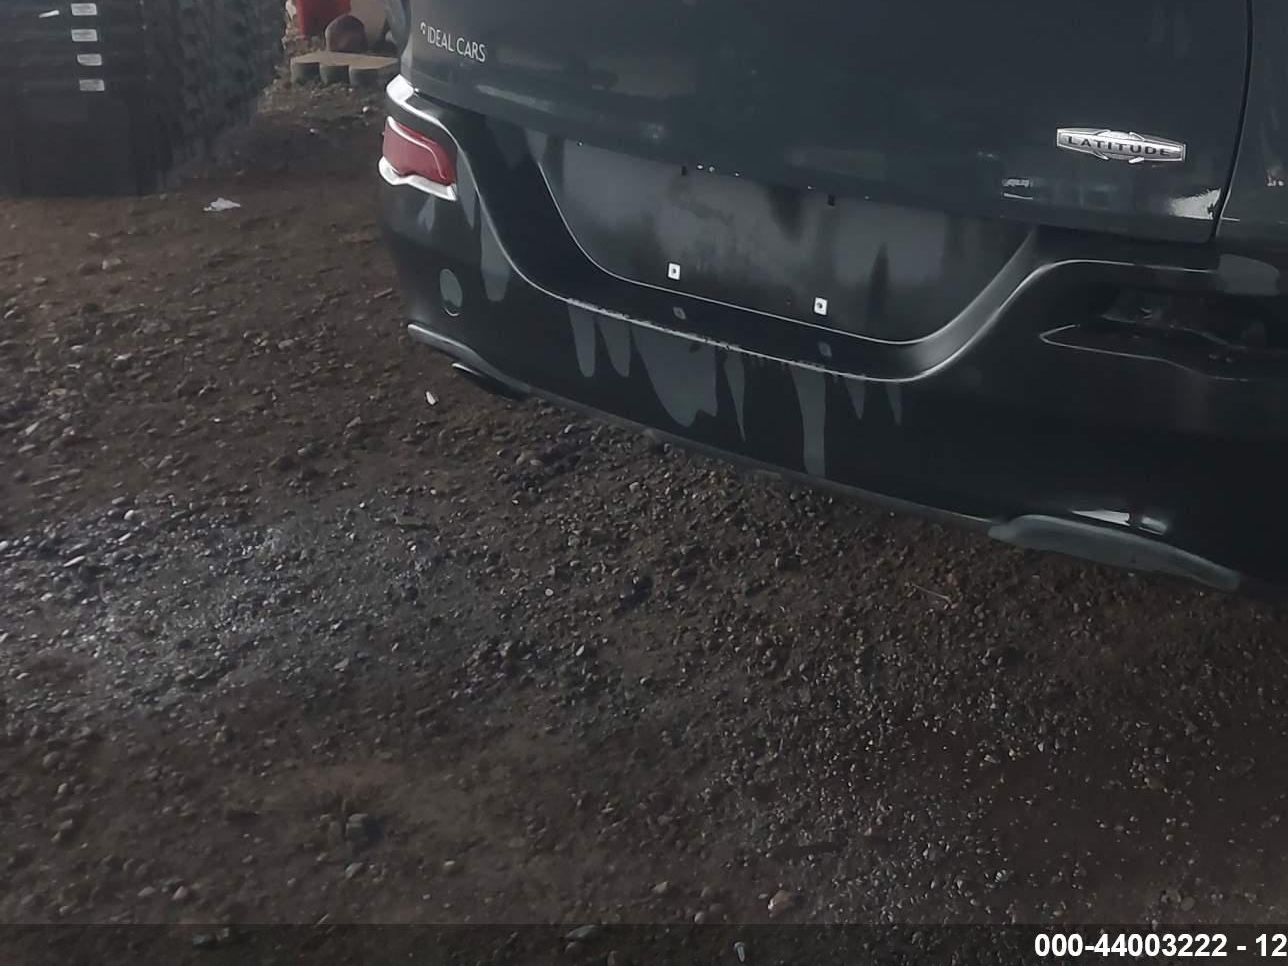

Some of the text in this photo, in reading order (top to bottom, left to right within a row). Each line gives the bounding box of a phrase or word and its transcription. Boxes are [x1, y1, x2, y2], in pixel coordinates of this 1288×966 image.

[427, 26, 486, 63] IDEAL CARS
[1067, 135, 1173, 157] LATITUDE
